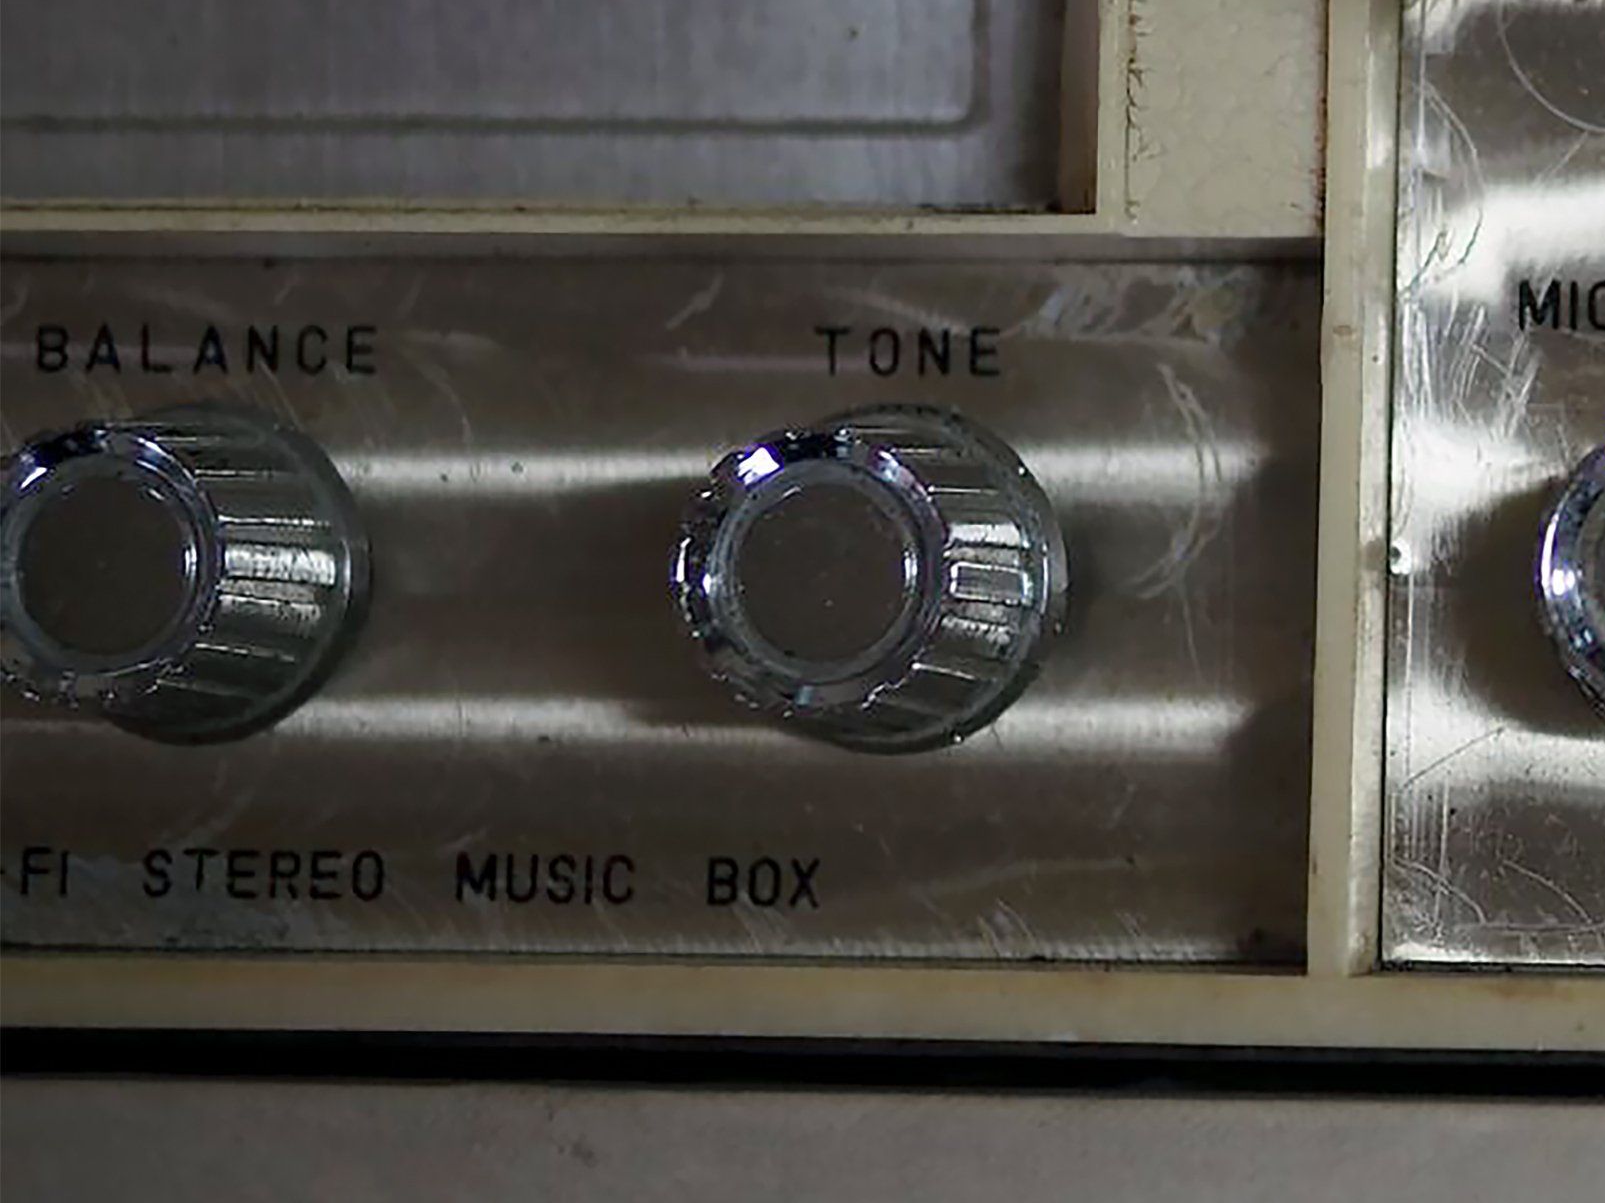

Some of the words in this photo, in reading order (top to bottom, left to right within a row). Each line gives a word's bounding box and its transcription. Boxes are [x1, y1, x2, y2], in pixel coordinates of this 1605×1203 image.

[33, 323, 379, 375] BALANCE
[813, 324, 1002, 378] TONE
[0, 845, 70, 898] FI
[141, 847, 387, 903] STEREO
[455, 851, 638, 907] MUSIC
[705, 855, 823, 910] BOX
